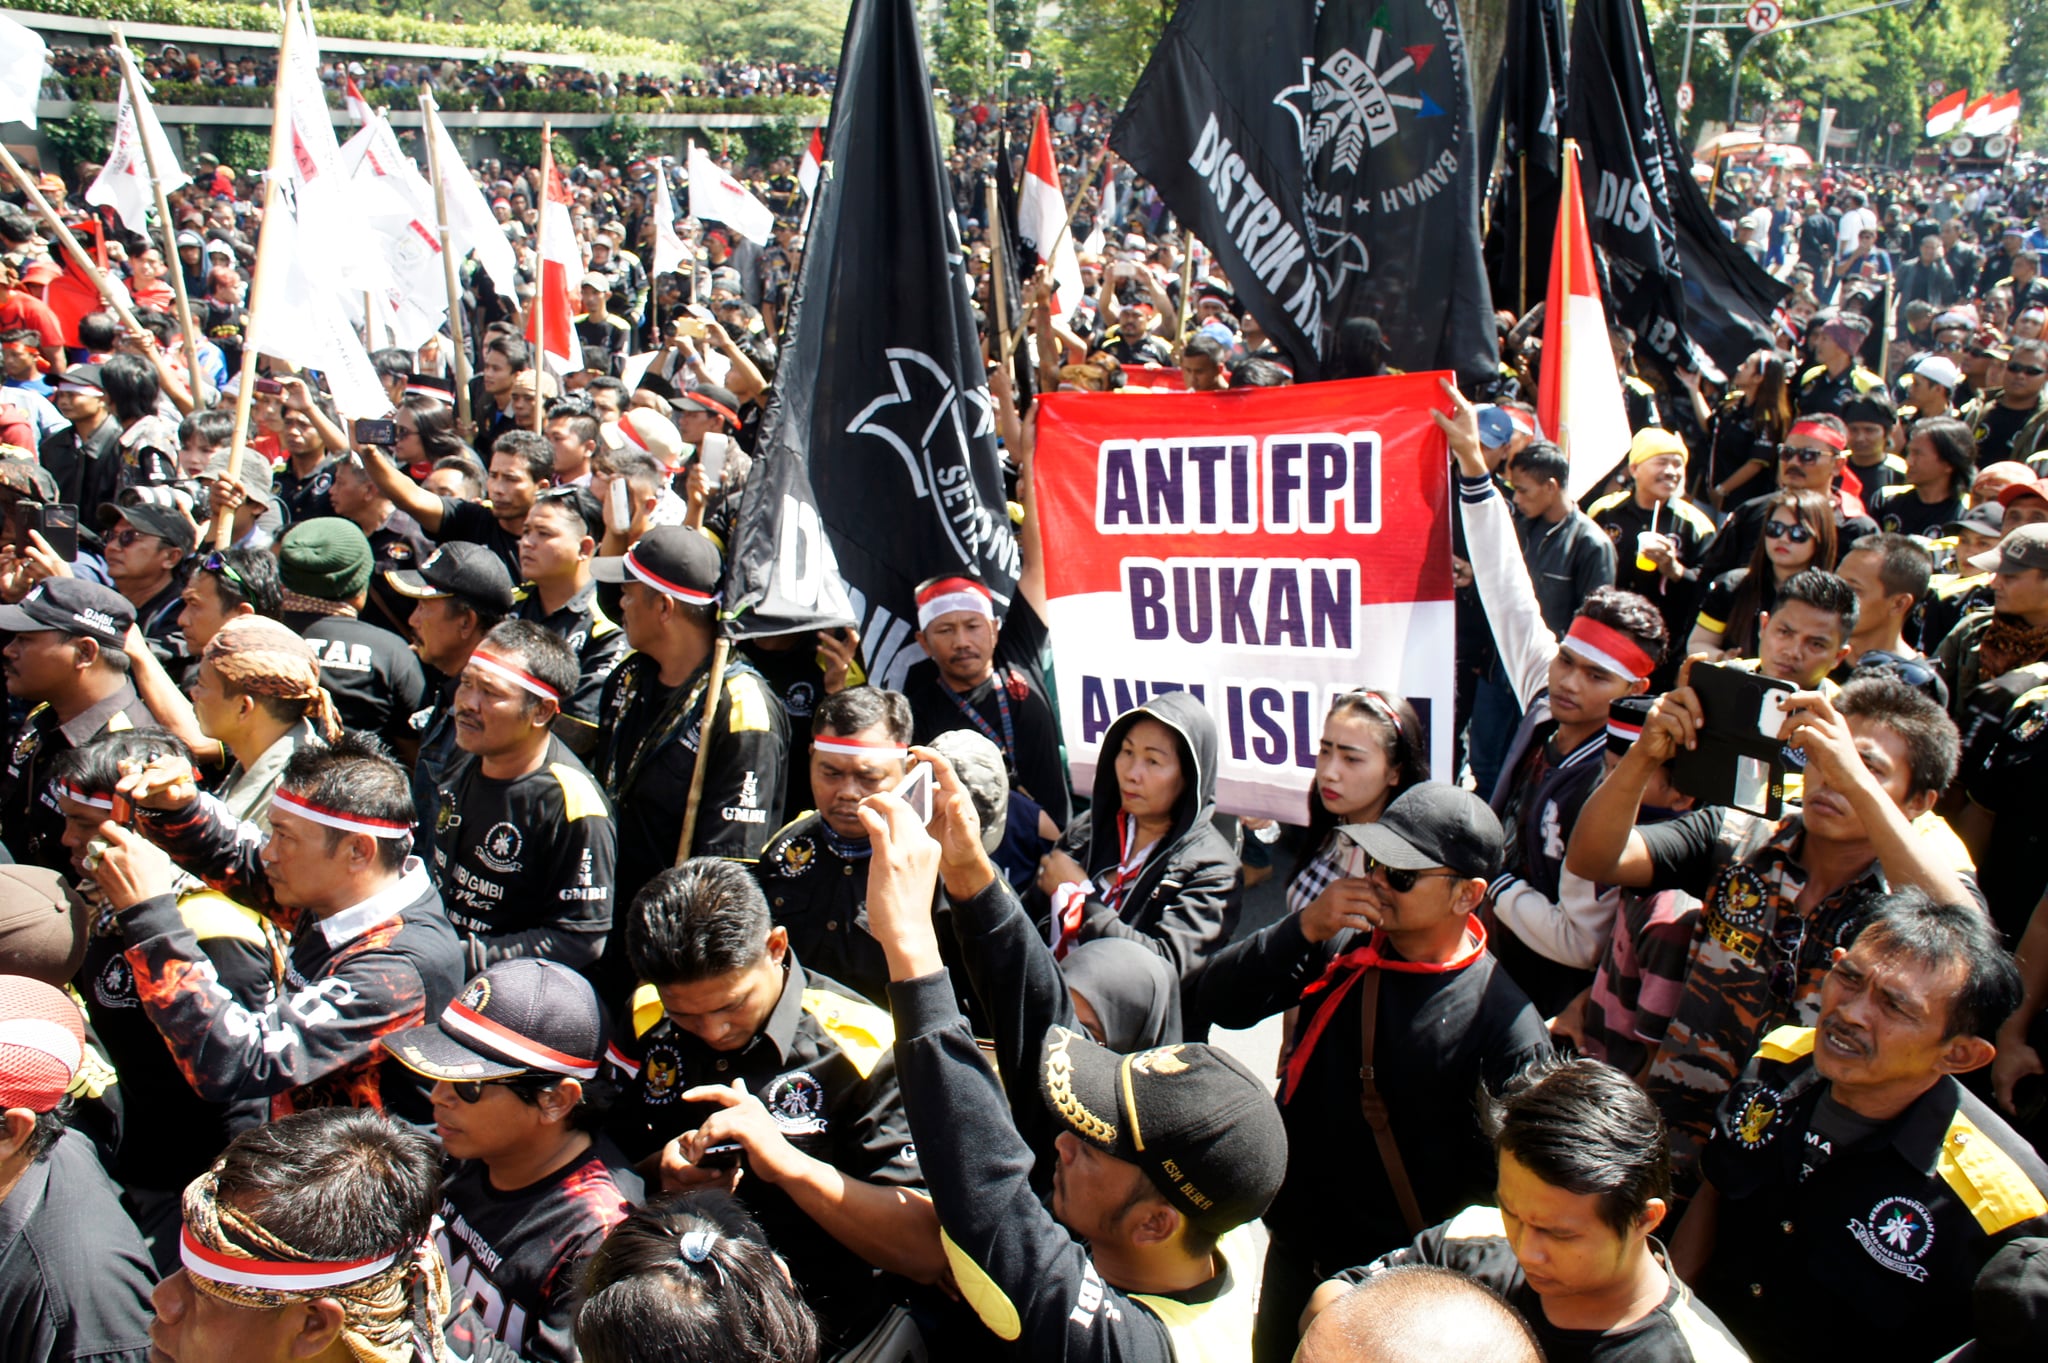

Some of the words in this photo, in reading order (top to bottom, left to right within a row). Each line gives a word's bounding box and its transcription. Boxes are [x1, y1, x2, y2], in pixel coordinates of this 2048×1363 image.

[1333, 56, 1391, 132] GMBI
[1189, 112, 1305, 295] DISTRIK
[1381, 149, 1459, 213] BAWAH
[1103, 446, 1249, 525] ANTI
[1271, 441, 1373, 525] FPI
[1128, 565, 1353, 650] BUKAN
[1226, 684, 1432, 781] ISL
[558, 886, 608, 901] GMBI
[451, 1214, 503, 1274] ANNIVERSARY
